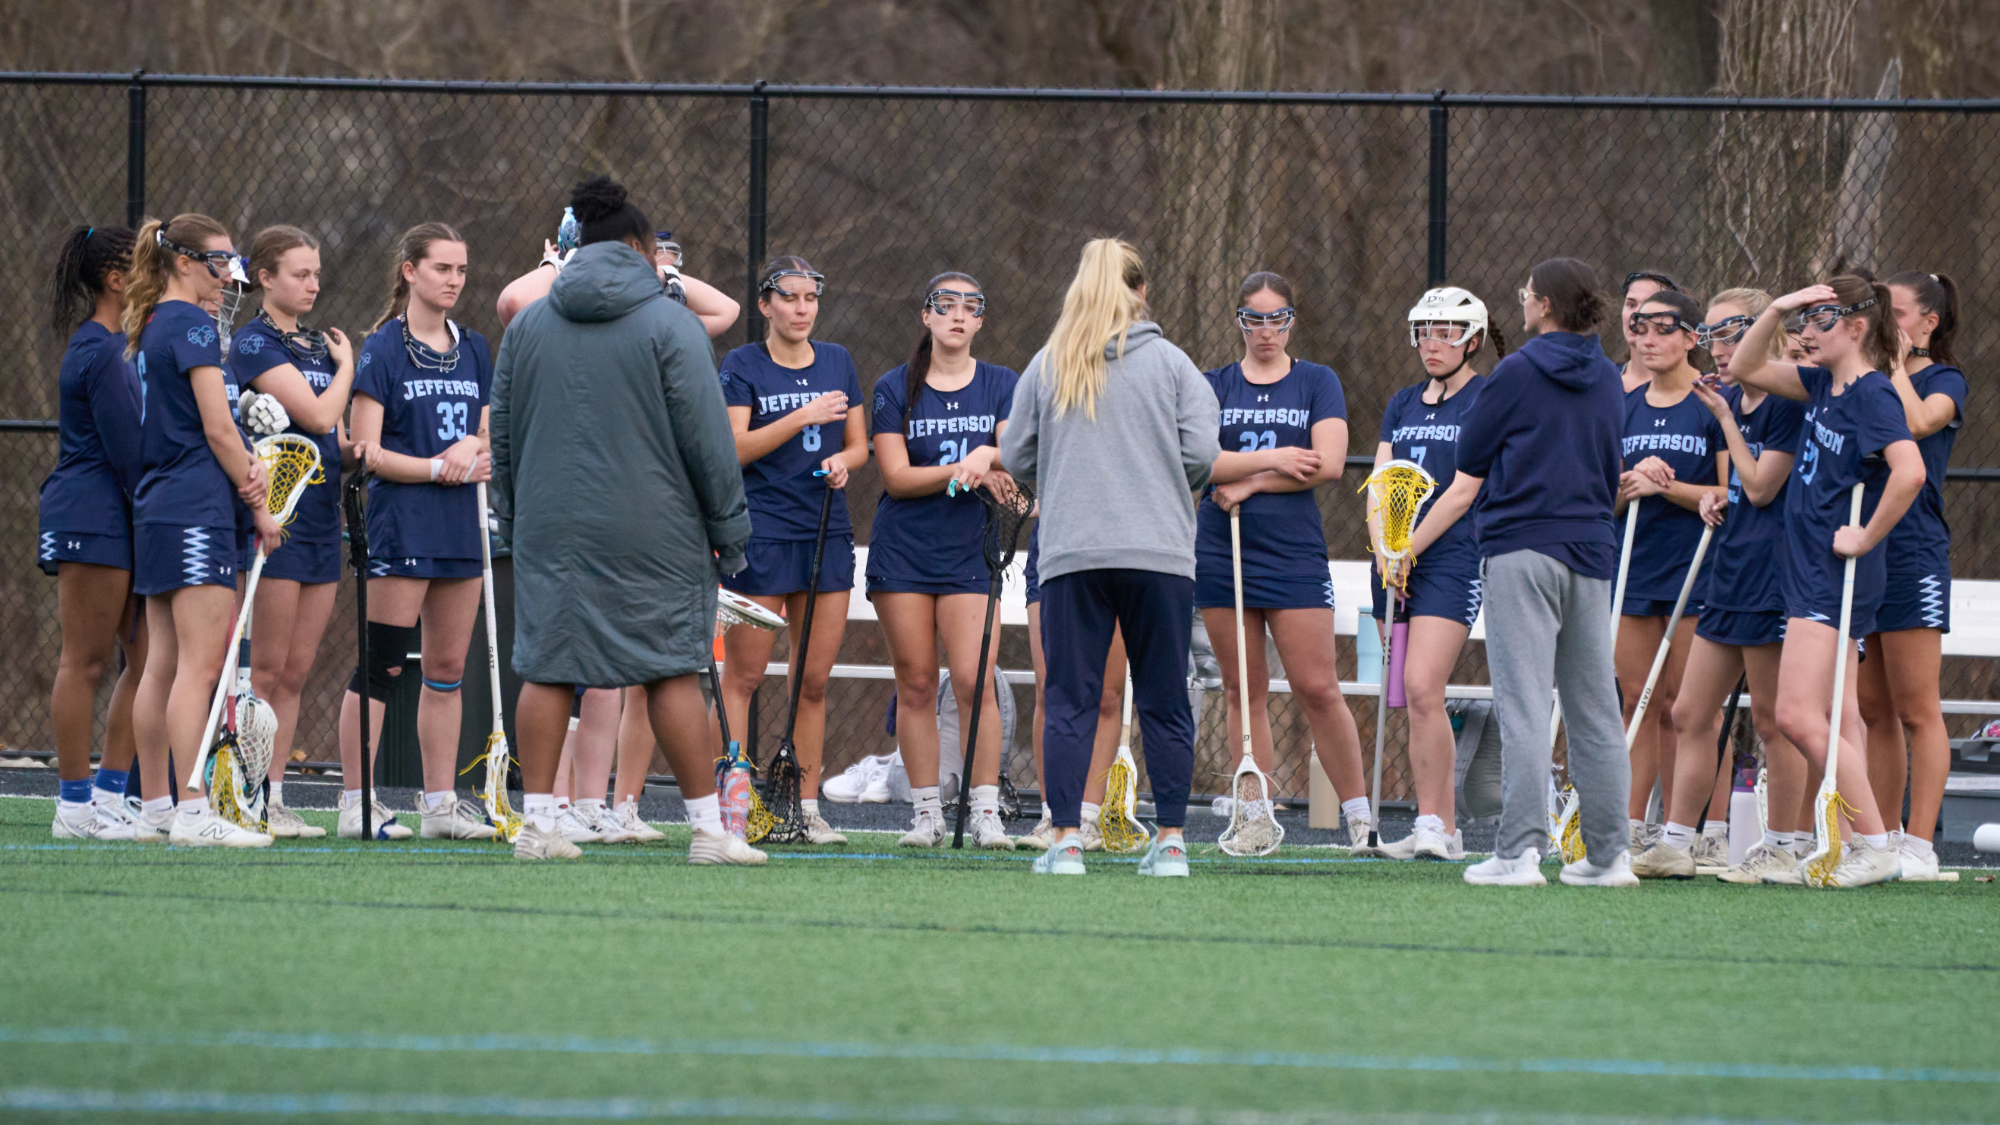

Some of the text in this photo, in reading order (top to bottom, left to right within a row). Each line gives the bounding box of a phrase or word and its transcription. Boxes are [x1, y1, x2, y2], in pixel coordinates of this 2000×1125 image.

[403, 380, 480, 401] JEFFERSO
[436, 401, 468, 441] 33
[802, 424, 821, 452] 8
[1621, 433, 1707, 458] JEFFERSON
[1410, 446, 1427, 467] 7
[1640, 687, 1651, 711] GAIT
